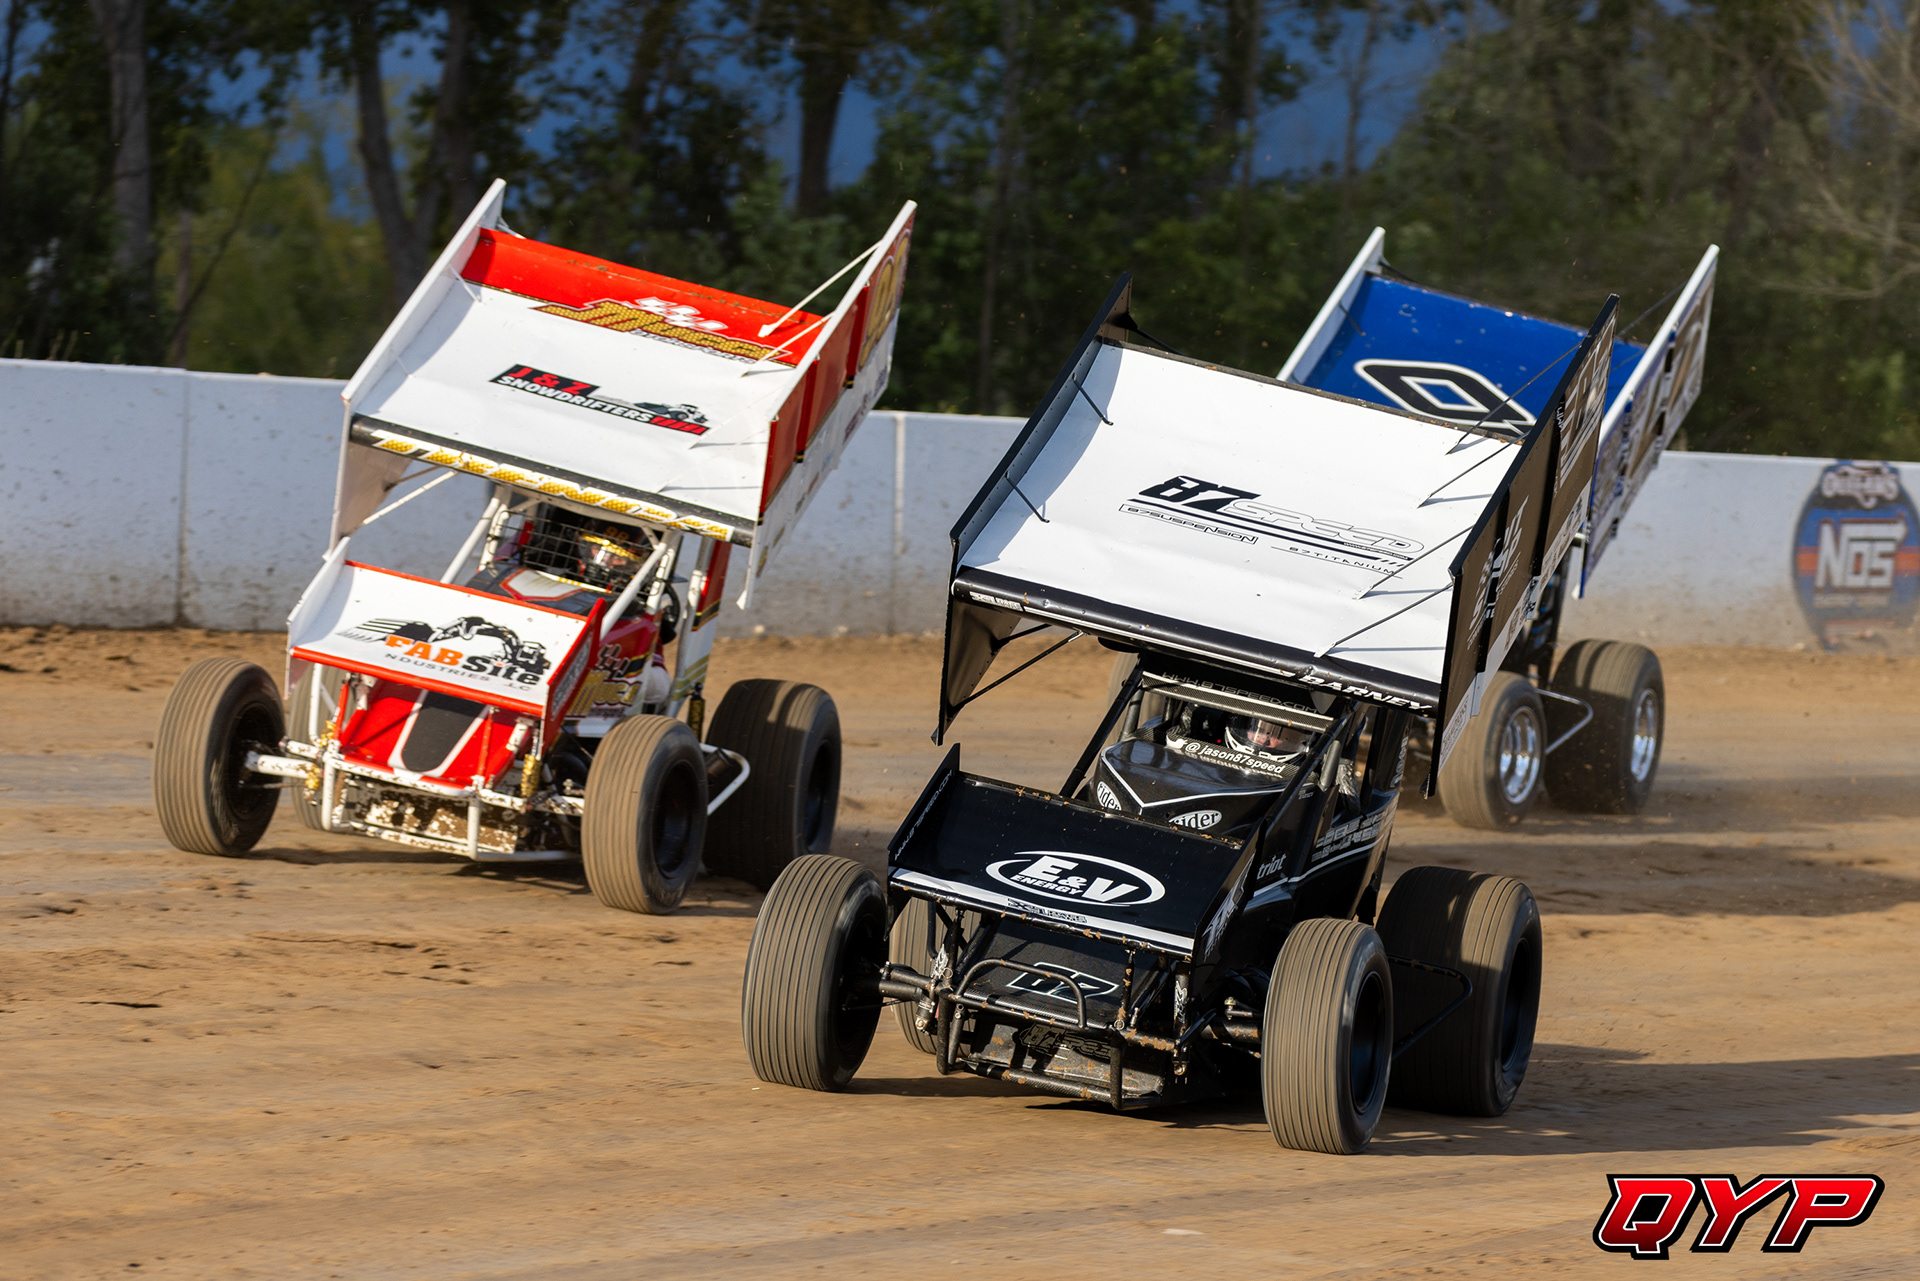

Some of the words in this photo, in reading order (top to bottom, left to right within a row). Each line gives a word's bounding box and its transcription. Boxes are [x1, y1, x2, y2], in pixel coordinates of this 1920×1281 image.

[508, 366, 534, 379] J
[533, 374, 559, 389] &
[561, 381, 593, 395] Z
[498, 376, 653, 423] SNOWDRIFTERS
[1139, 475, 1262, 512] 87
[1127, 507, 1256, 544] 87SUSPENSION
[1223, 498, 1425, 554] SPEED
[1289, 546, 1396, 574] 87TITANIUM
[1814, 518, 1908, 590] NOS
[385, 634, 464, 667] FAB
[462, 655, 541, 685] Site
[1185, 742, 1286, 775] @jason87speed
[1170, 812, 1219, 830] ider
[1256, 853, 1287, 880] triot
[1010, 874, 1084, 896] ENERGY
